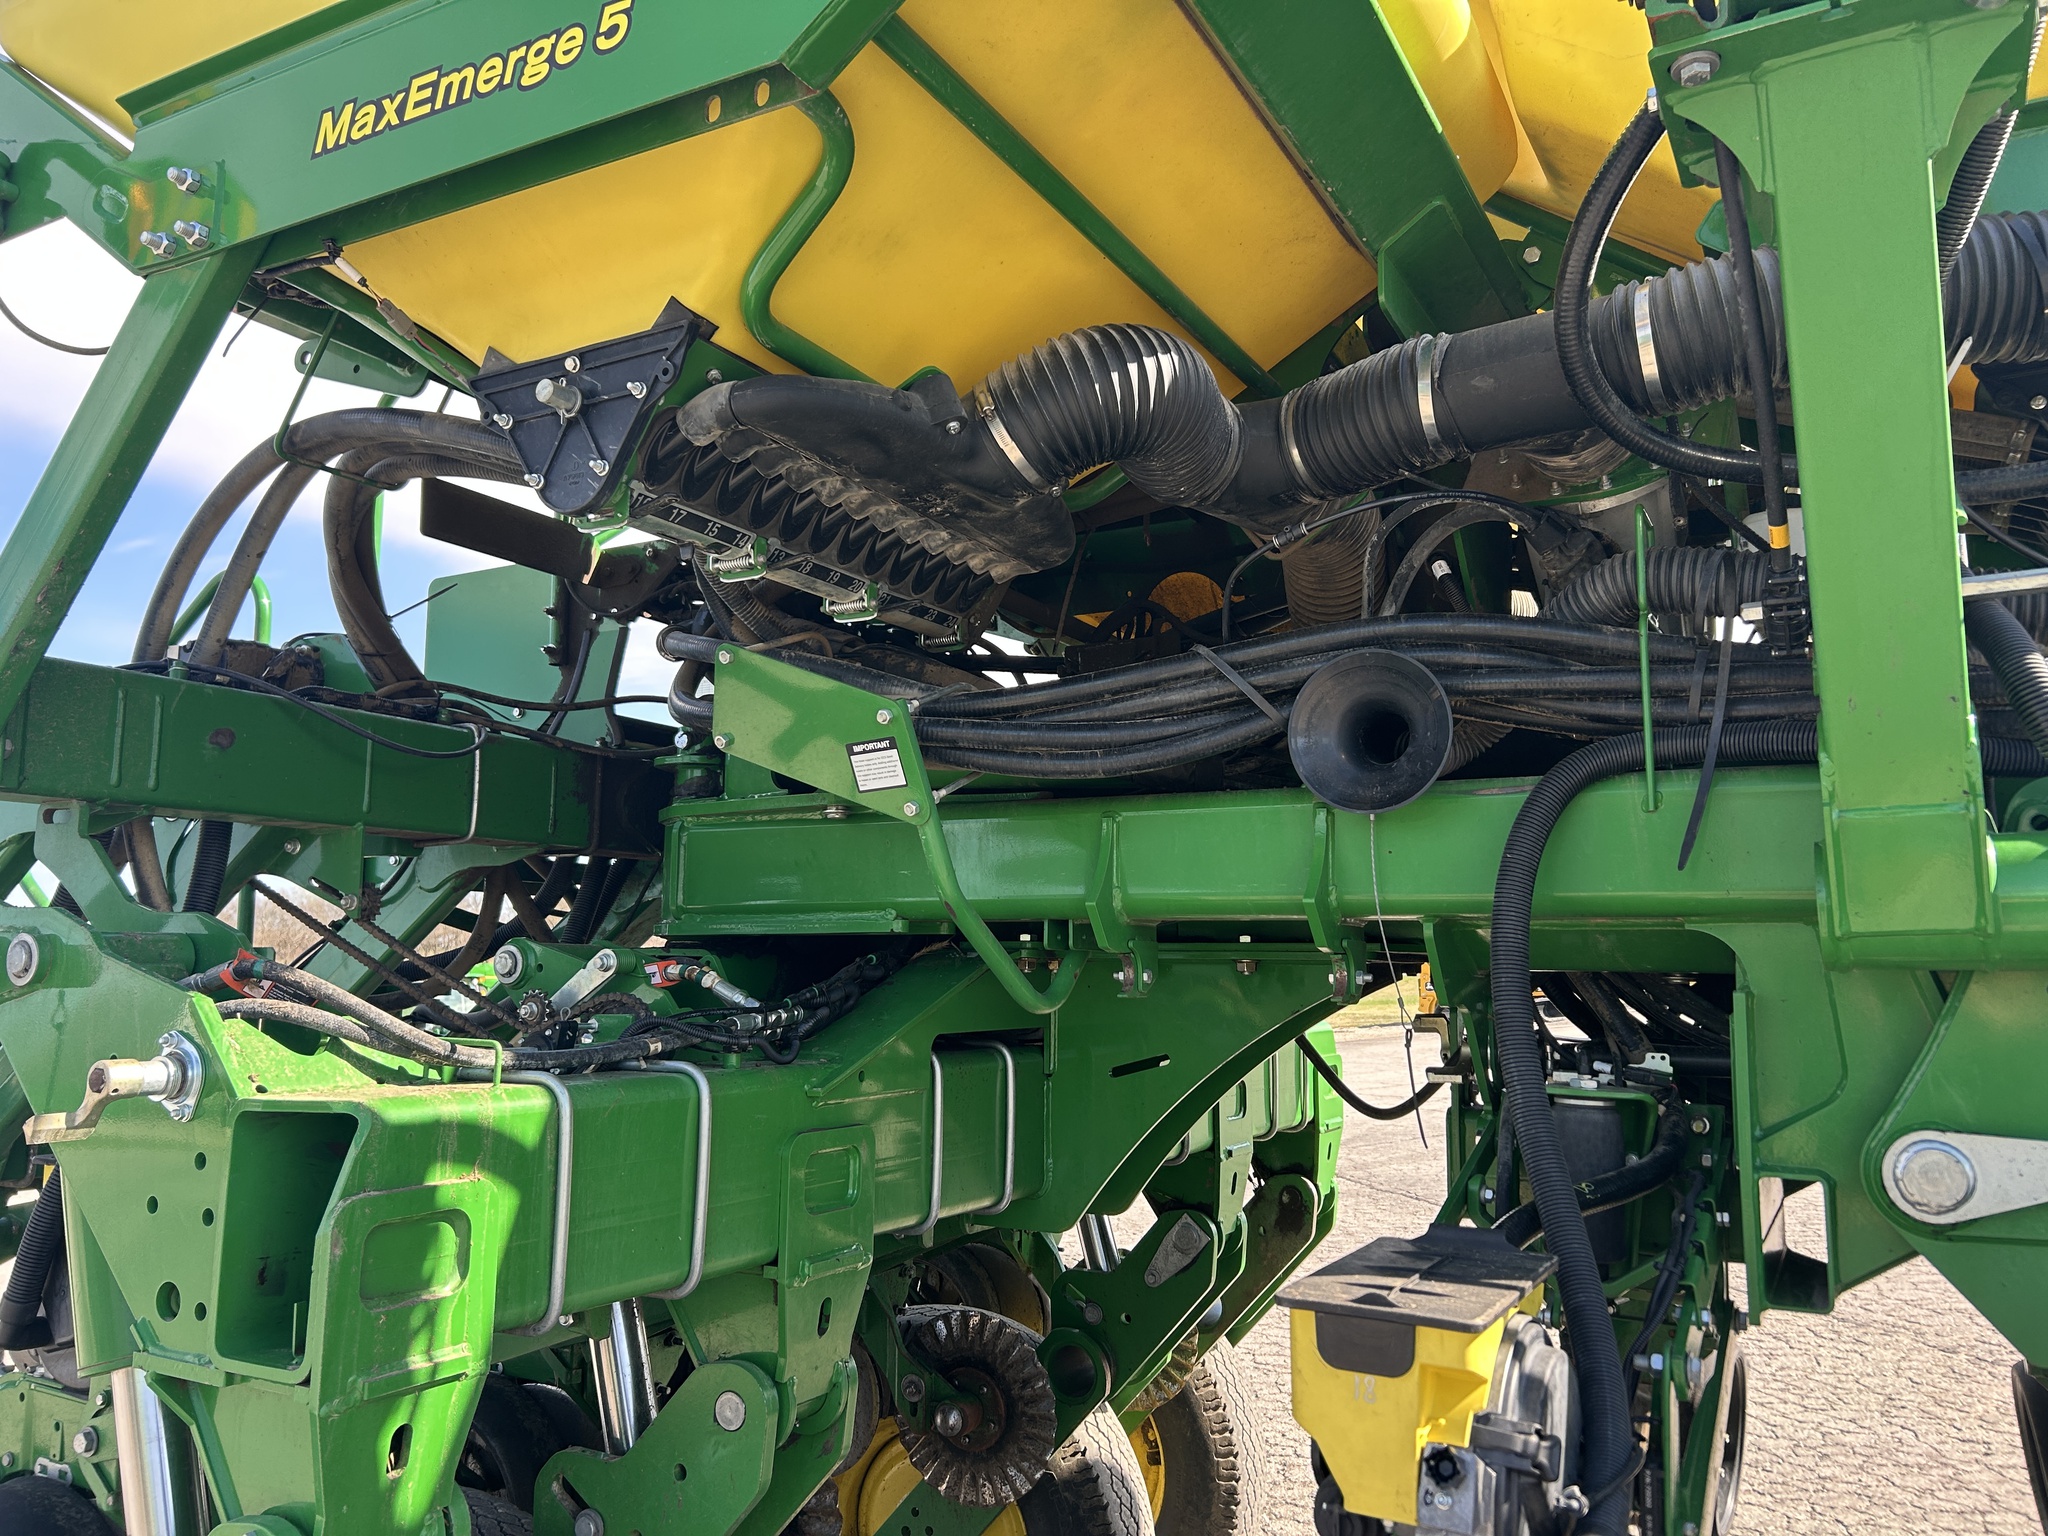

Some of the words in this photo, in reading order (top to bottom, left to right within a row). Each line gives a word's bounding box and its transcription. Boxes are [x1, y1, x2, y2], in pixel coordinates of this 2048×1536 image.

[312, 24, 586, 157] MaxEmerge
[594, 0, 633, 52] 5
[668, 508, 687, 523] 17
[704, 521, 721, 537] 15
[732, 533, 749, 547] 14
[798, 561, 813, 574] 18
[826, 571, 841, 584] 19
[848, 579, 863, 592] 20
[924, 609, 938, 621] 23
[943, 616, 957, 627] 24
[852, 740, 890, 752] IMPORTANT
[1353, 1374, 1377, 1404] 18
